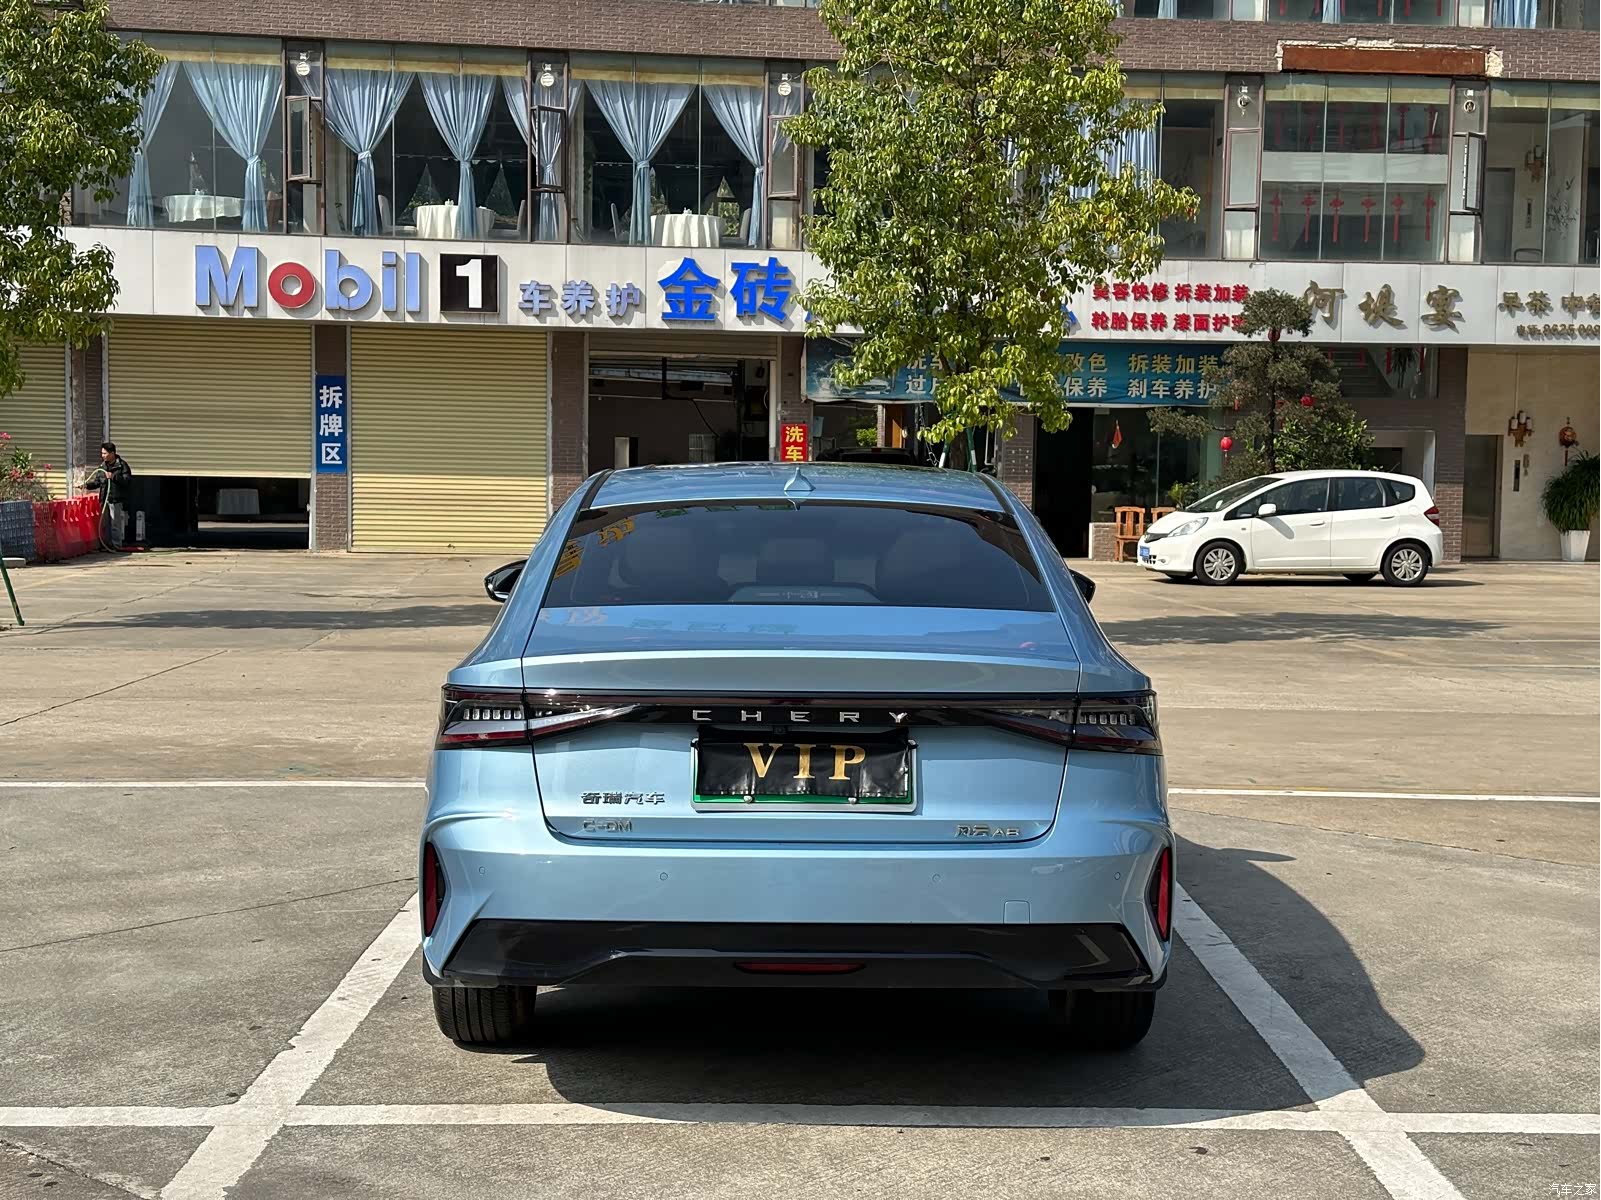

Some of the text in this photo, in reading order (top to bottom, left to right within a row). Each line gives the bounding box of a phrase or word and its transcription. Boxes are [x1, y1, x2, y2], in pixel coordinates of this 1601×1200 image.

[195, 244, 421, 313] Mobil
[658, 256, 793, 323] 金砖
[519, 279, 640, 317] 车养护
[1093, 282, 1249, 302] 美容快修 拆装加装
[1499, 290, 1552, 314] 早茶
[1091, 311, 1168, 331] 轮胎保养
[1129, 354, 1219, 375] 拆装加装
[1127, 378, 1217, 400] 刹车养护
[319, 384, 343, 465] 拆牌区
[785, 425, 804, 461] 洗车
[692, 709, 908, 723] CHERY
[743, 742, 866, 780] VIP
[581, 792, 665, 805] 奇瑞汽车
